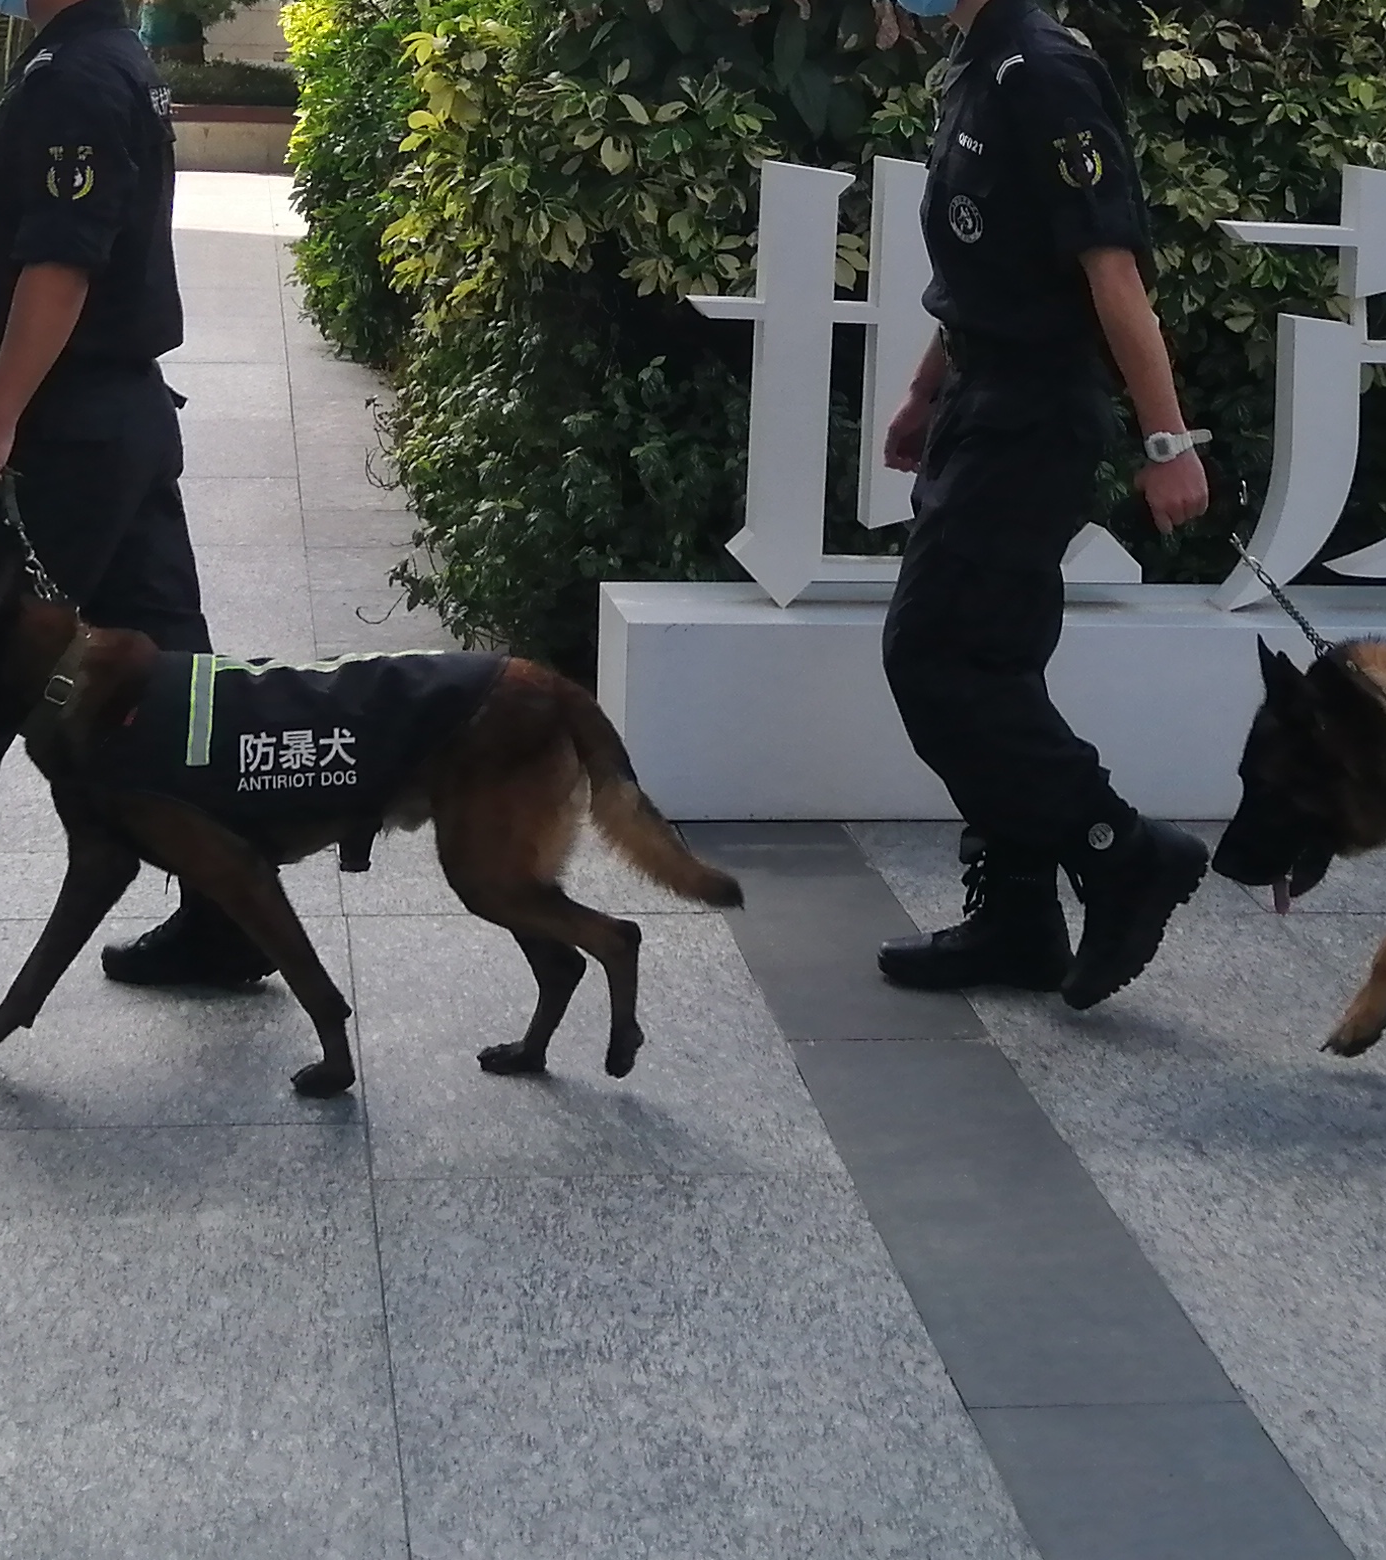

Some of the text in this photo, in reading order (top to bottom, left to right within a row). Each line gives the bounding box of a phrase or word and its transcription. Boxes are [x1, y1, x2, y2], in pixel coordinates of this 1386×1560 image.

[238, 727, 357, 774] 防暴犬
[237, 770, 357, 792] ANTIRIOT DOG
